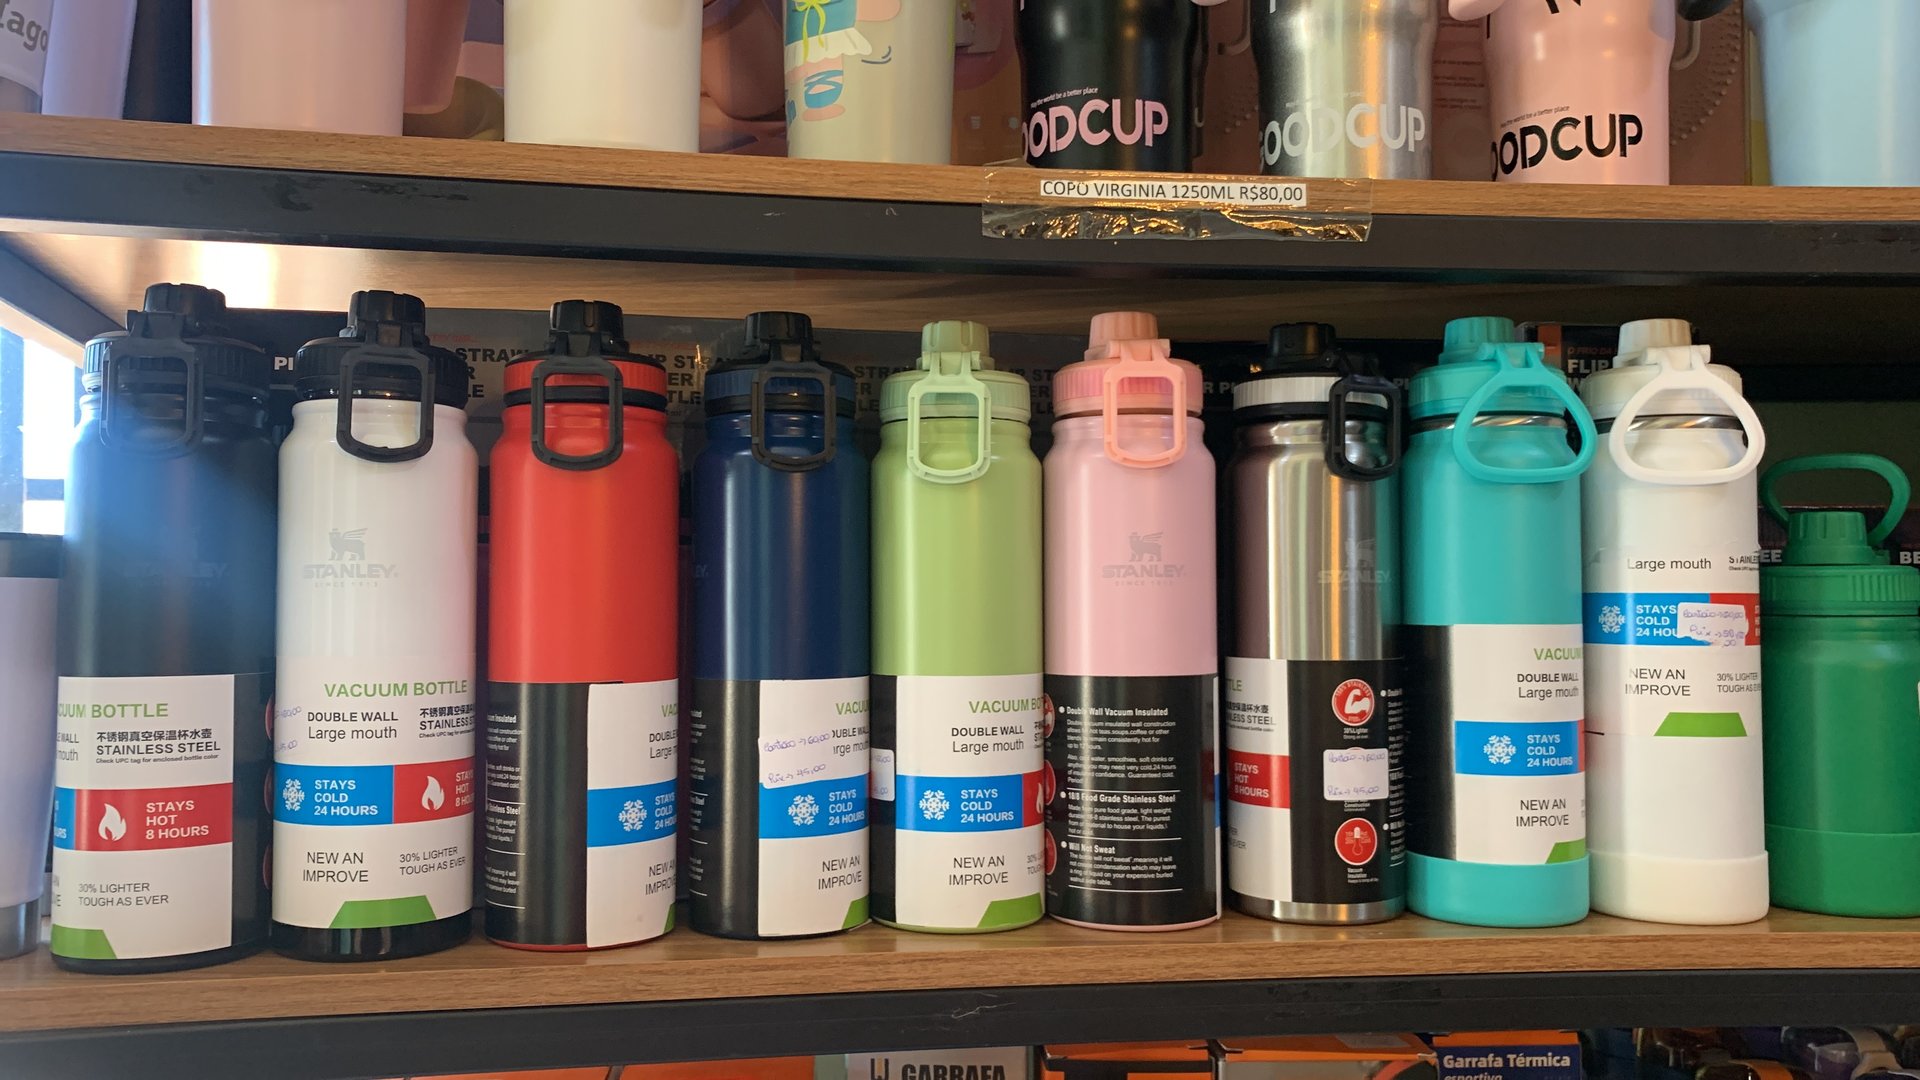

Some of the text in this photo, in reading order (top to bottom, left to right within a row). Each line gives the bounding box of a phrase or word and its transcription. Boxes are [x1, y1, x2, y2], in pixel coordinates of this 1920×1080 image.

[1082, 86, 1099, 96] place
[1554, 105, 1570, 114] place
[1042, 181, 1303, 203] COPO VIRGINIA 1250ML R$80,00
[1102, 564, 1184, 578] STANLEY
[1627, 558, 1712, 572] Large mouth
[303, 564, 396, 579] STANLEY
[1636, 604, 1677, 614] STAYS
[1636, 616, 1670, 626] COLD
[1636, 627, 1650, 637] 24
[1517, 672, 1579, 682] DOUBLE WALL
[1629, 668, 1685, 680] NEW AN
[1717, 673, 1733, 681] 30%
[324, 679, 468, 698] VACUUM BOTTLE
[1518, 686, 1579, 701] Large mouth
[1625, 684, 1691, 696] IMPROVE
[1717, 684, 1745, 693] TOUGH
[91, 703, 168, 719] BOTTLE
[969, 698, 1029, 714] VACUUM
[1105, 707, 1133, 716] Vacuum
[1135, 708, 1168, 716] Insulated
[307, 711, 399, 722] DOUBLE WALL
[1247, 714, 1277, 726] STEEL
[419, 717, 469, 731] STAINLESS
[308, 726, 397, 742] Large mouth
[951, 725, 1024, 737] DOUBLE WALL
[1527, 735, 1561, 744] STAYS
[96, 741, 221, 756] STAINLESS STEEL
[952, 739, 1024, 755] Large mouth
[1527, 746, 1556, 756] COLD
[130, 757, 141, 765] tag
[1527, 757, 1573, 767] 24 HOURS
[1234, 762, 1259, 775] STAYS
[1234, 773, 1249, 784] HOT
[314, 780, 356, 790] STAYS
[456, 783, 469, 795] HOT
[314, 793, 348, 803] COLD
[828, 789, 856, 802] STAYS
[960, 788, 998, 799] STAYS
[1239, 786, 1270, 798] HOURS
[1099, 794, 1121, 803] Grade
[1123, 794, 1156, 803] Stainless
[1158, 794, 1176, 803] Steel
[146, 800, 195, 814] STAYS
[314, 805, 379, 816] 24 HOURS
[655, 805, 673, 817] COLD
[828, 802, 853, 814] COLD
[960, 801, 992, 811] COLD
[1520, 799, 1566, 811] NEW AN
[146, 814, 178, 827] HOT
[828, 810, 865, 825] 24 HOURS
[960, 811, 1014, 823] 24 HOURS
[1516, 815, 1569, 827] IMPROVE
[655, 819, 663, 830] 24
[146, 825, 210, 840] 8 HOURS
[400, 846, 458, 863] 30% LIGHTER
[1094, 844, 1116, 854] Sweat
[307, 852, 364, 864] NEW AN
[822, 855, 860, 872] NEW AN
[953, 855, 1005, 868] NEW AN
[400, 863, 435, 876] TOUGH
[437, 862, 448, 871] AS
[303, 870, 369, 883] IMPROVE
[818, 870, 862, 890] IMPROVE
[948, 872, 1008, 885] IMPROVE
[78, 882, 150, 893] 30% LIGHTER
[79, 894, 169, 907] TOUGH AS EVER
[1443, 1052, 1571, 1068] Garrafa Térmica
